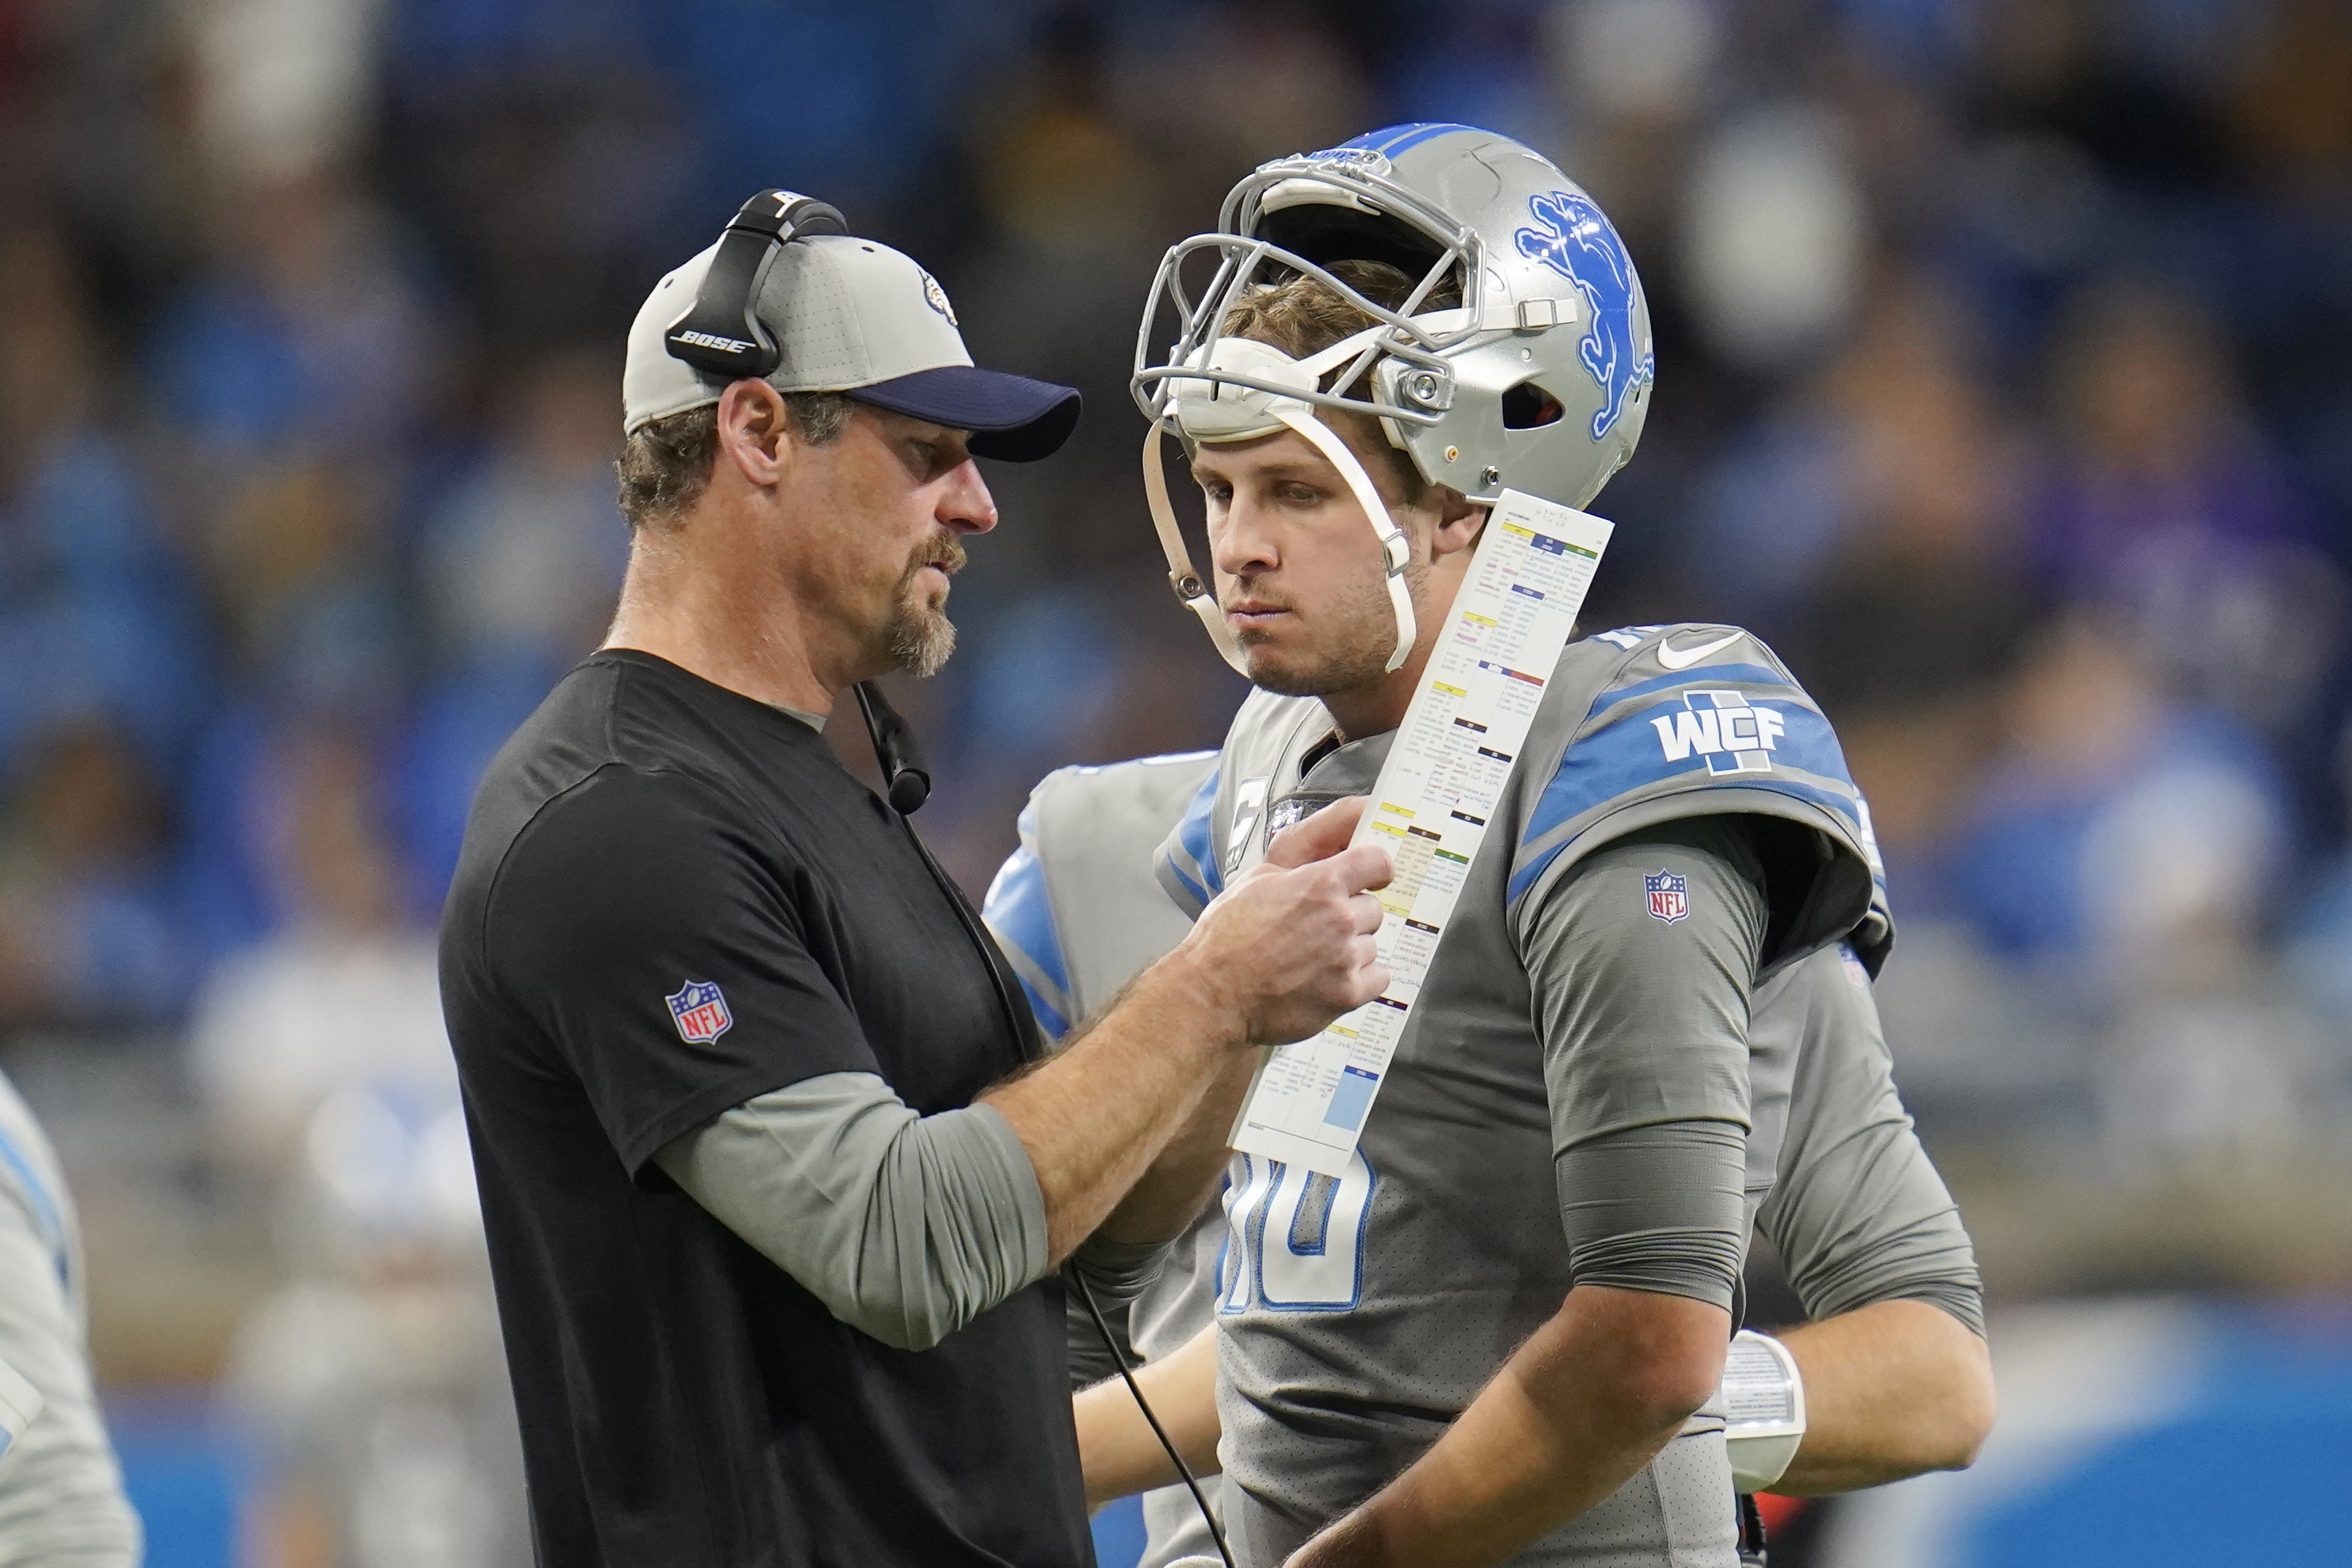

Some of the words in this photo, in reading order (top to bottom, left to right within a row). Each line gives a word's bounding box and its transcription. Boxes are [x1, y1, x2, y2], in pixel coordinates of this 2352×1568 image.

[669, 330, 756, 354] BOSE
[1650, 706, 1785, 762] WCF
[1650, 892, 1685, 917] NFL
[680, 1003, 726, 1037] NFL
